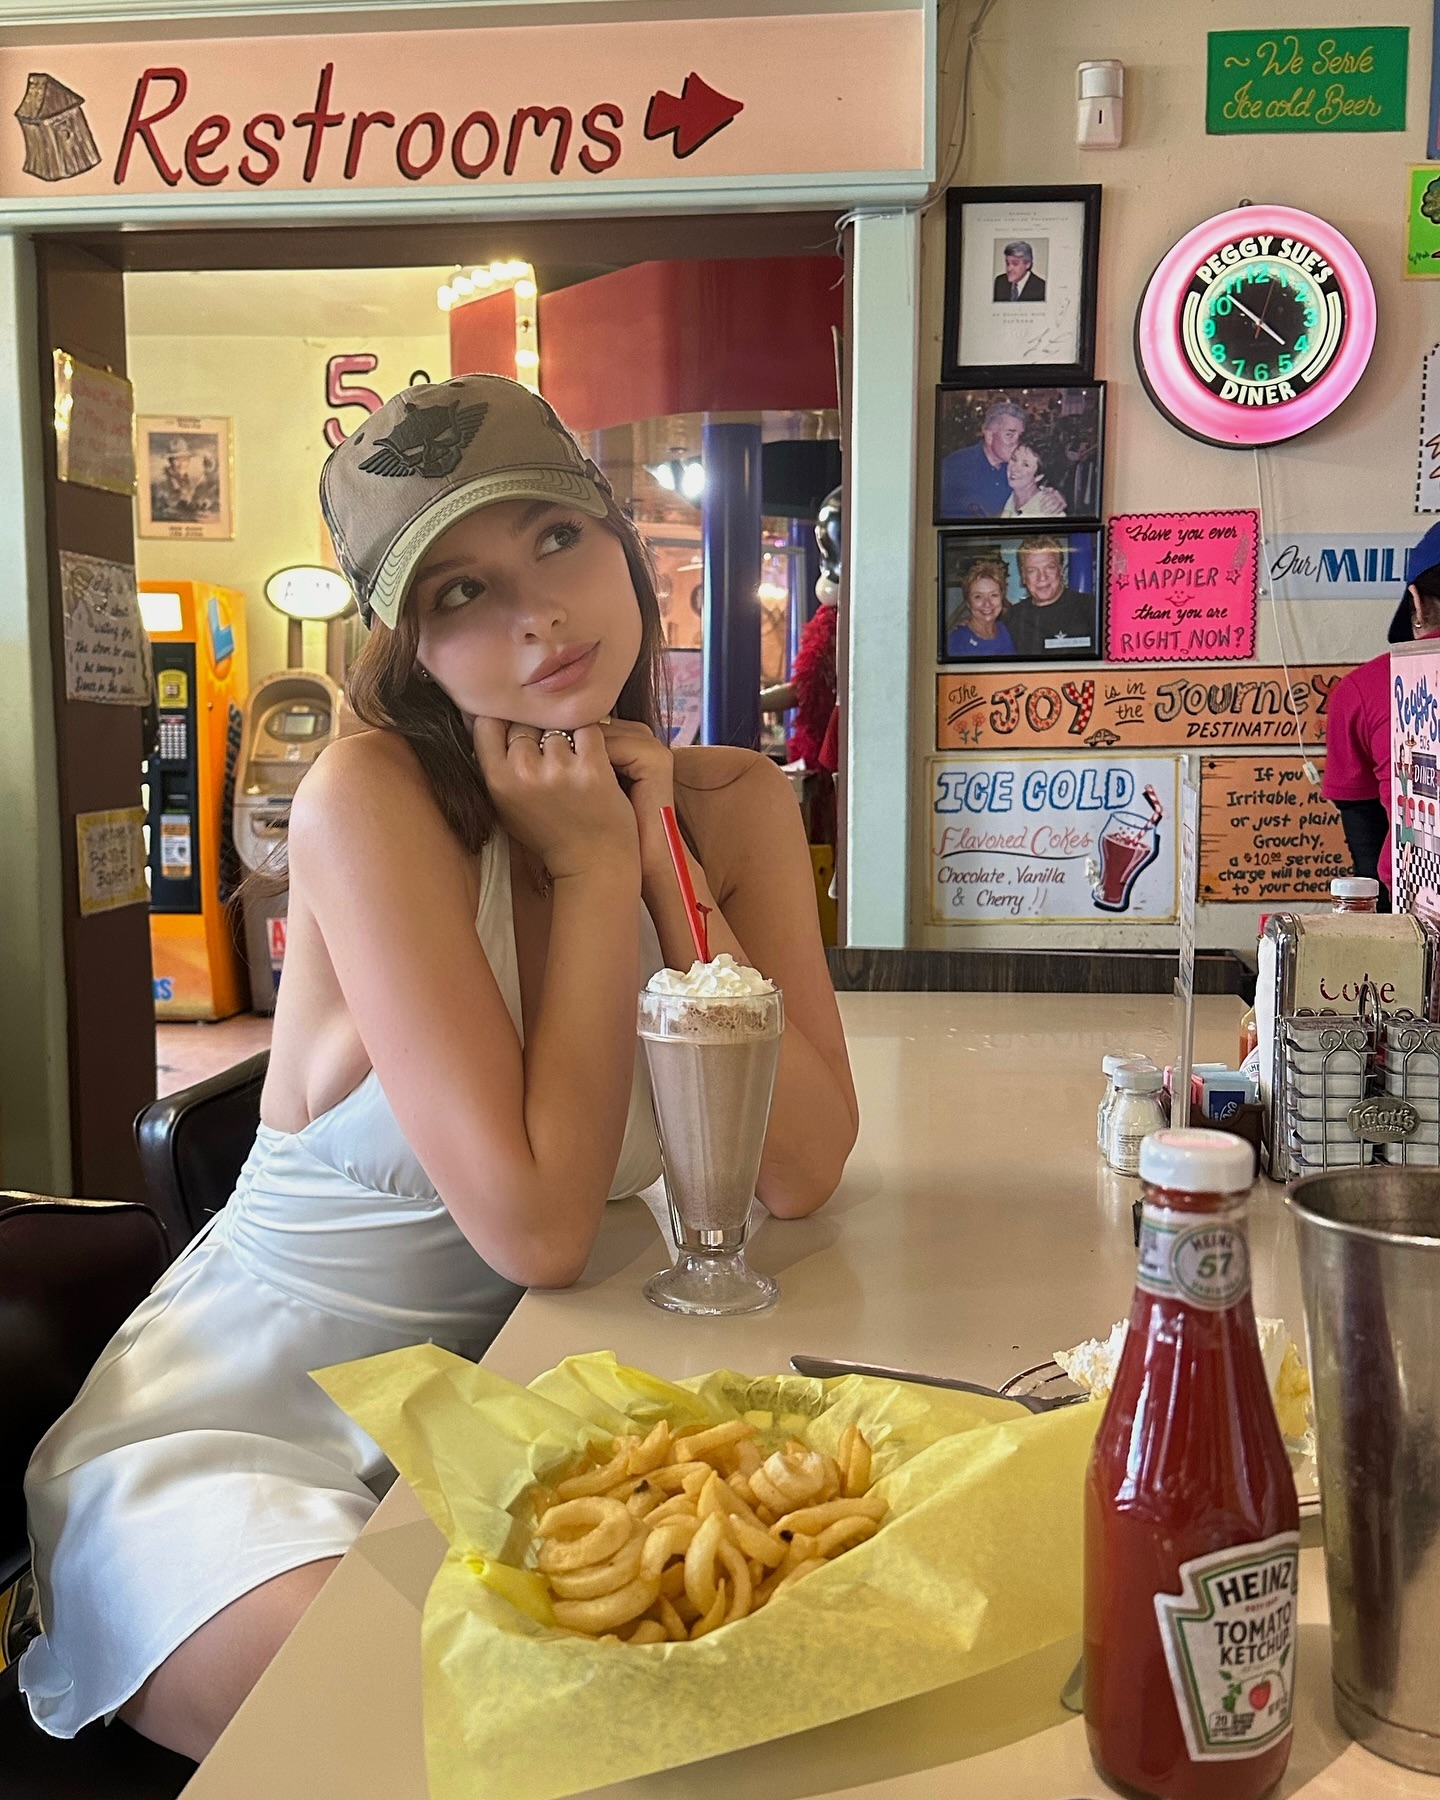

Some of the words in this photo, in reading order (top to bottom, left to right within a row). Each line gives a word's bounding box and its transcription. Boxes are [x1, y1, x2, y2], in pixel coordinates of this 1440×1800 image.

[1256, 35, 1304, 76] We
[1312, 39, 1374, 75] Serve
[1223, 80, 1262, 119] Ice
[1265, 86, 1316, 118] cold
[1315, 83, 1382, 124] Beer
[113, 62, 624, 186] Restrooms
[1195, 235, 1274, 285] PEGGY
[1277, 237, 1334, 284] SUE'S
[1245, 263, 1271, 285] 12
[1279, 268, 1288, 288] 1
[1294, 282, 1309, 302] 2
[1208, 296, 1232, 317] 10
[1202, 318, 1216, 338] 9
[1303, 307, 1318, 328] 3
[1211, 343, 1227, 364] 8
[1294, 335, 1310, 354] 4
[1231, 359, 1246, 378] 7
[1253, 363, 1270, 381] 6
[1278, 353, 1293, 373] 5
[1219, 378, 1297, 406] DINER
[1126, 523, 1172, 541] Have
[1175, 527, 1204, 547] you
[1208, 526, 1238, 540] ever
[1156, 551, 1195, 564] been
[1271, 545, 1317, 581] Our
[1134, 567, 1219, 591] HAPPIER
[1131, 603, 1171, 620] than
[1172, 610, 1202, 626] you
[1206, 607, 1228, 618] are
[1120, 630, 1182, 654] RIGHT
[948, 683, 978, 704] The
[1104, 684, 1120, 699] is
[1127, 679, 1147, 695] in
[989, 680, 1096, 735] JOY
[1116, 703, 1144, 719] the
[1187, 721, 1307, 738] DESTINATION
[1254, 767, 1274, 782] If
[1278, 770, 1303, 786] you
[1413, 764, 1436, 788] DINER
[933, 770, 1014, 814] ICE
[1022, 768, 1135, 812] COLD
[1231, 815, 1249, 828] or
[1252, 814, 1291, 831] just
[932, 825, 1028, 856] Flavored
[1229, 856, 1238, 867] a
[1284, 851, 1343, 867] service
[1016, 864, 1066, 884] Vanilla
[1218, 866, 1265, 883] charge
[1271, 866, 1292, 879] will
[1296, 867, 1311, 879] be
[1232, 883, 1249, 896] to
[1259, 883, 1291, 897] your
[952, 887, 964, 906] &
[976, 888, 1025, 915] Cherry
[1197, 1252, 1233, 1278] 57
[1216, 1561, 1291, 1608] HEINZ
[1214, 1600, 1291, 1645] TOMATO
[1220, 1627, 1289, 1666] KETCHUP
